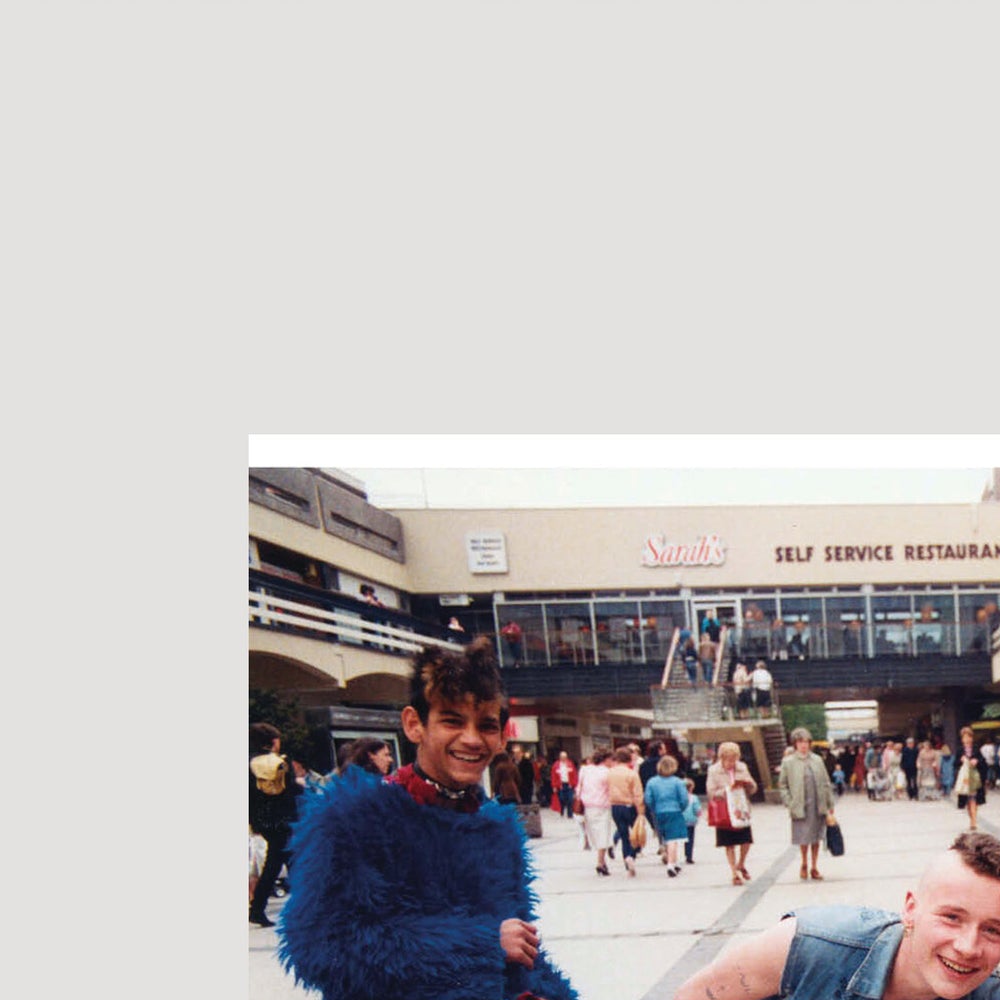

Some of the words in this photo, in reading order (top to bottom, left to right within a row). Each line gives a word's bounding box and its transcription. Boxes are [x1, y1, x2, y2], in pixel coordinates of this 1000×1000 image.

[643, 534, 723, 564] Sarah's
[775, 547, 814, 563] SELF
[824, 545, 894, 562] SERVICE
